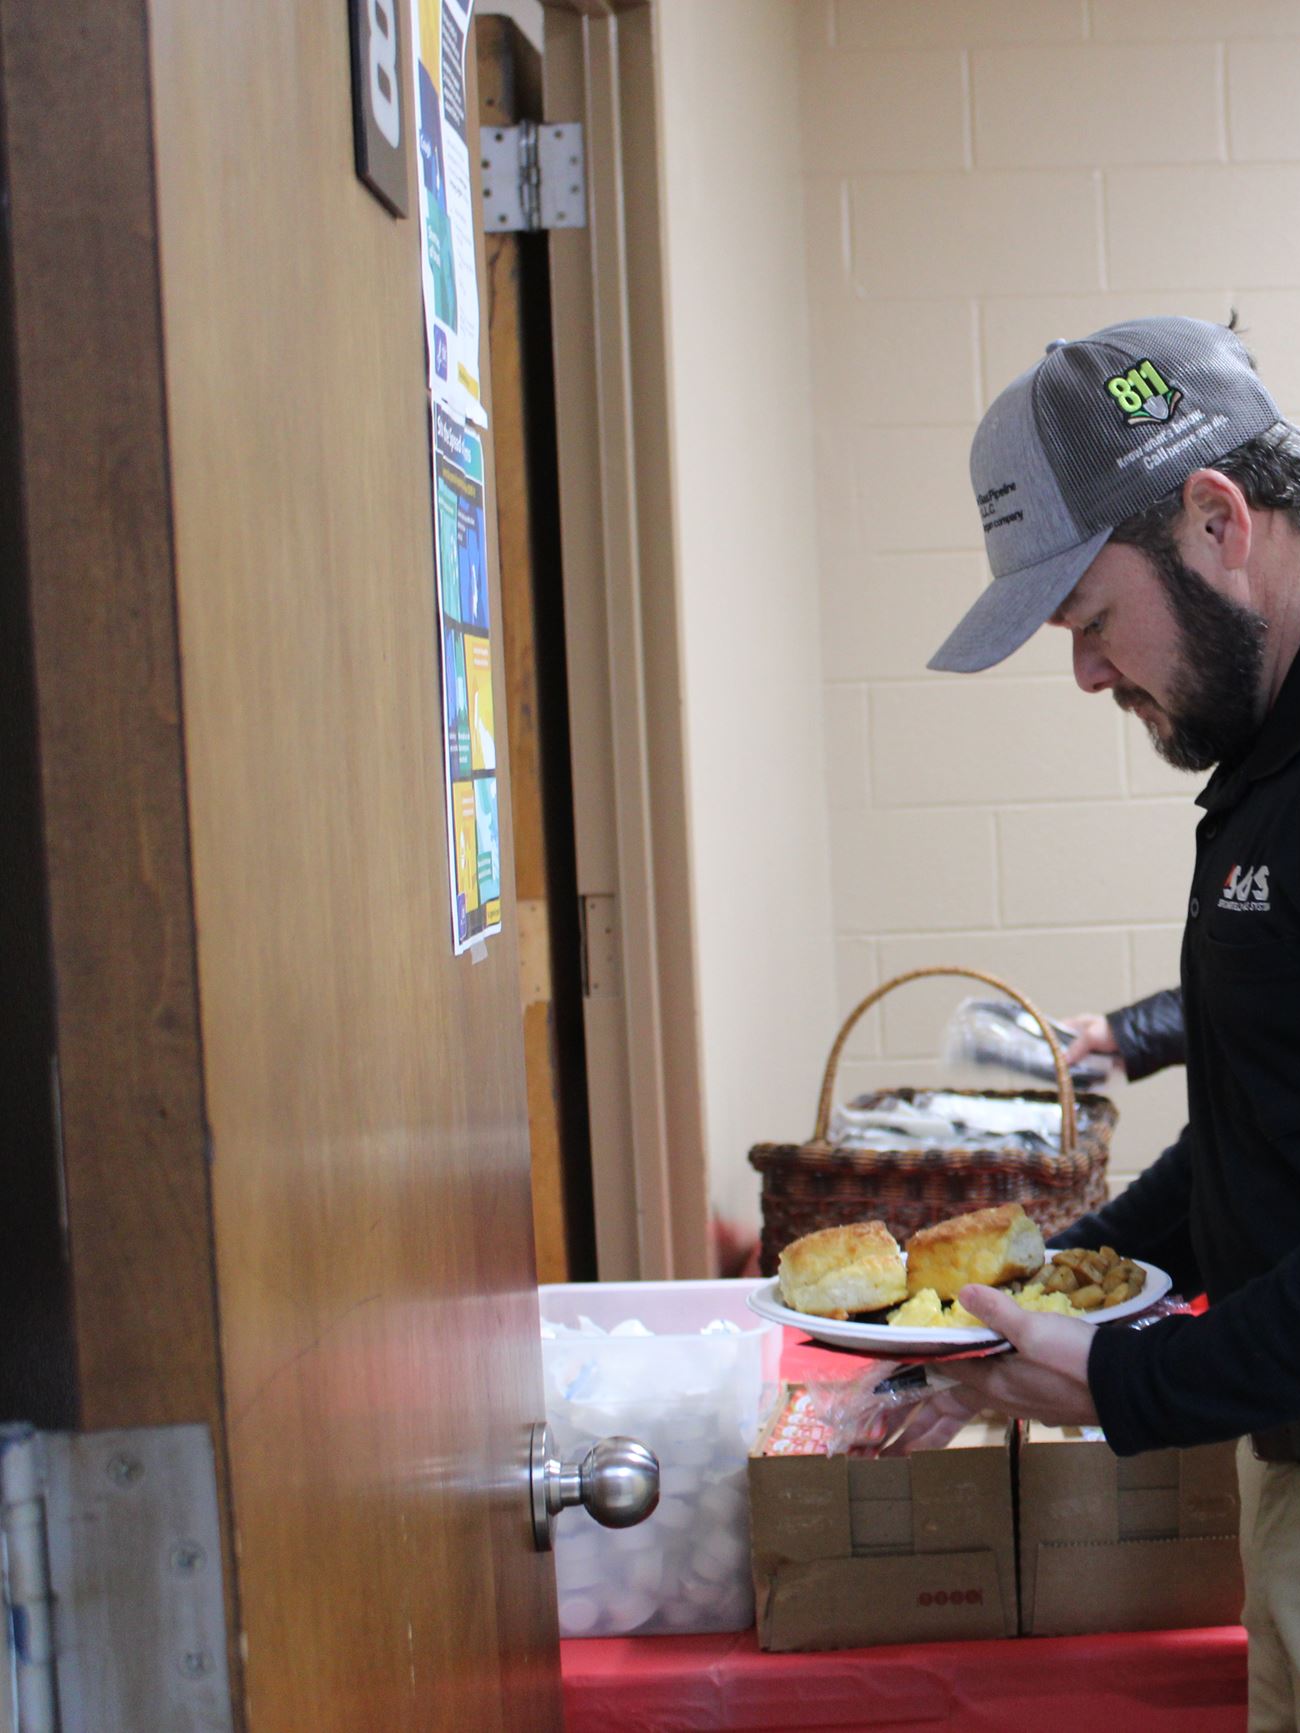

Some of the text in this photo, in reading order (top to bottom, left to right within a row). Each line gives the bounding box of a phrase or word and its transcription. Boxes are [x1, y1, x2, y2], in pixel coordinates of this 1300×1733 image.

[1108, 360, 1169, 413] 811
[1116, 409, 1206, 469] Know what's below.
[1143, 447, 1169, 470] Call
[1166, 434, 1197, 457] before
[993, 510, 1024, 527] company
